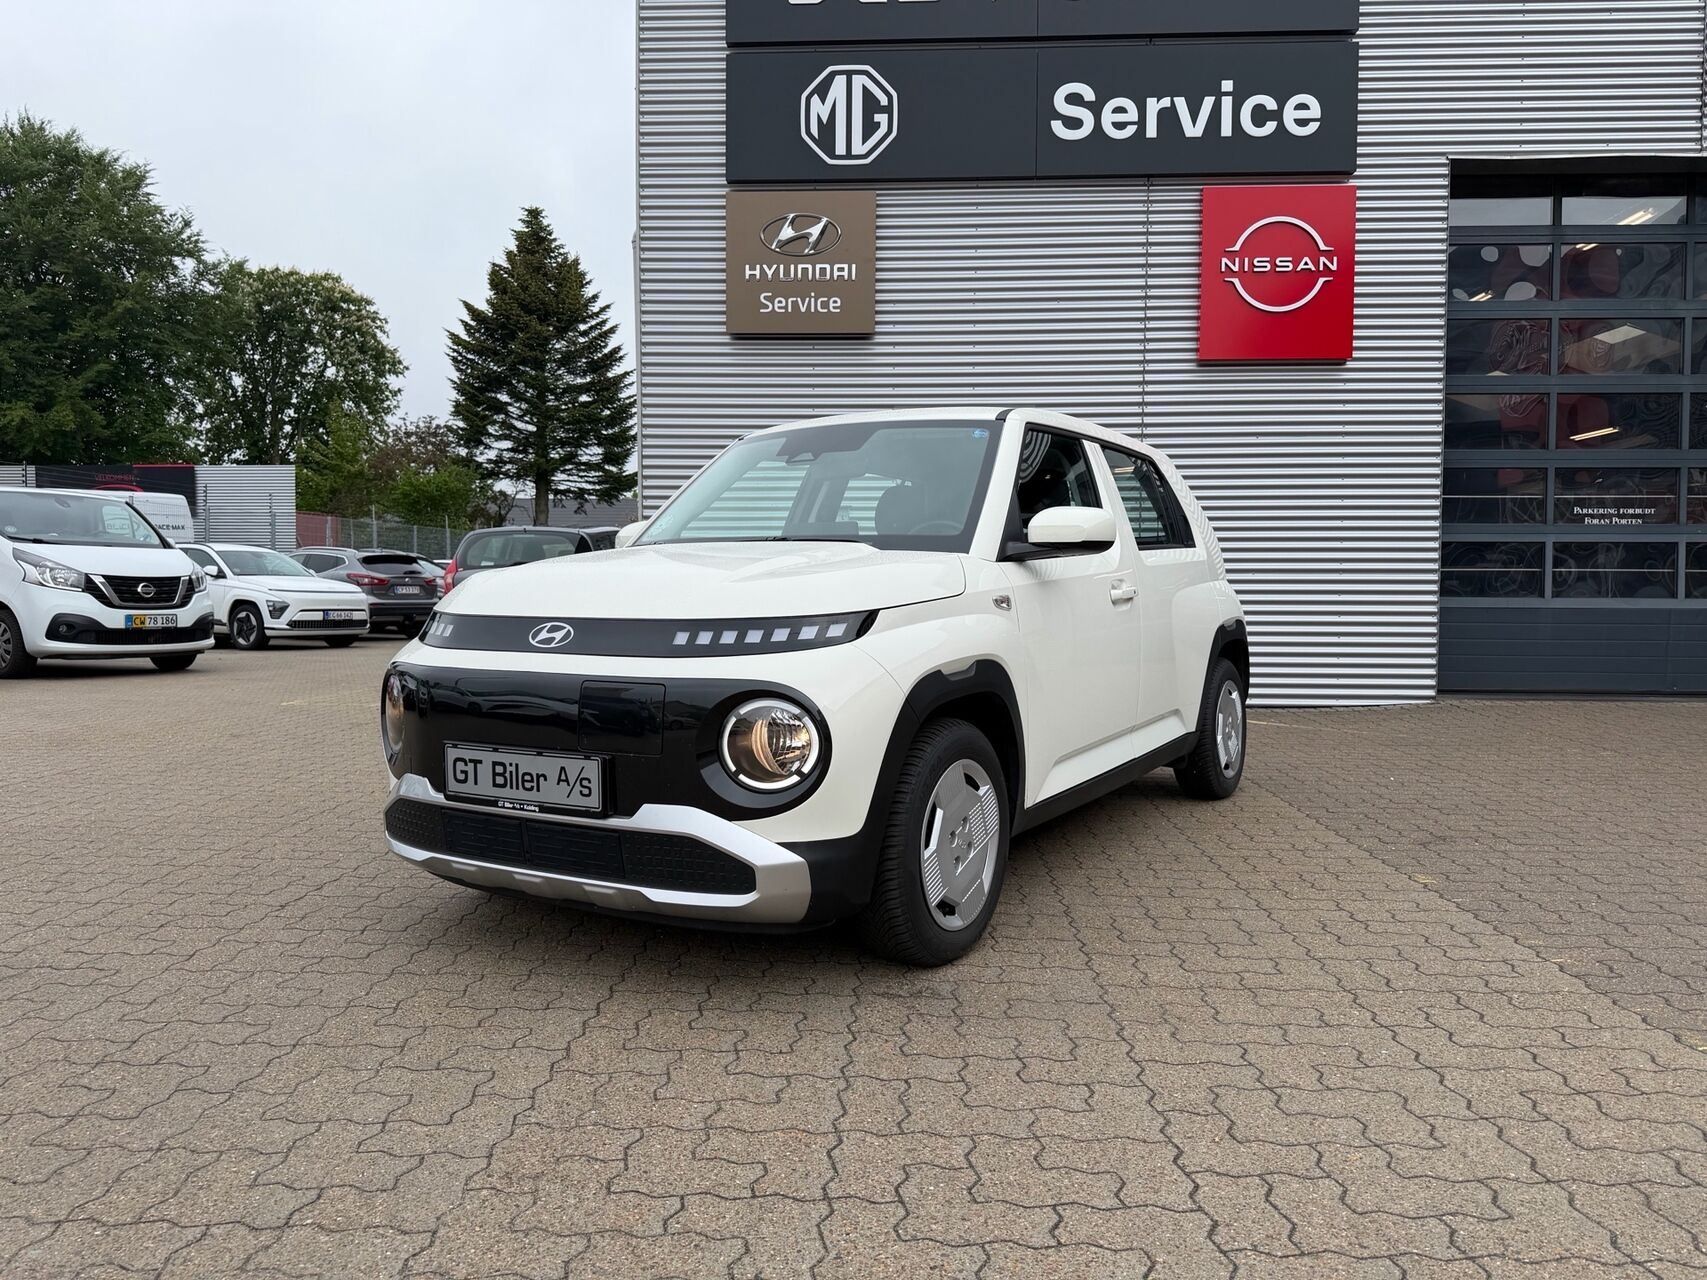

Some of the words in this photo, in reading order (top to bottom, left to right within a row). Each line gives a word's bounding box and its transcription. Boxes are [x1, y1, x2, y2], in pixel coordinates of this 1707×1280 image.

[1050, 79, 1322, 141] Service
[745, 264, 857, 282] HYUNDAI
[1221, 256, 1338, 273] NISSAN
[759, 292, 842, 313] Service
[133, 616, 146, 626] CW
[147, 616, 158, 626] 78
[160, 615, 176, 625] 186
[452, 757, 483, 786] GT
[491, 760, 548, 793] Biler
[556, 765, 593, 799] A/S
